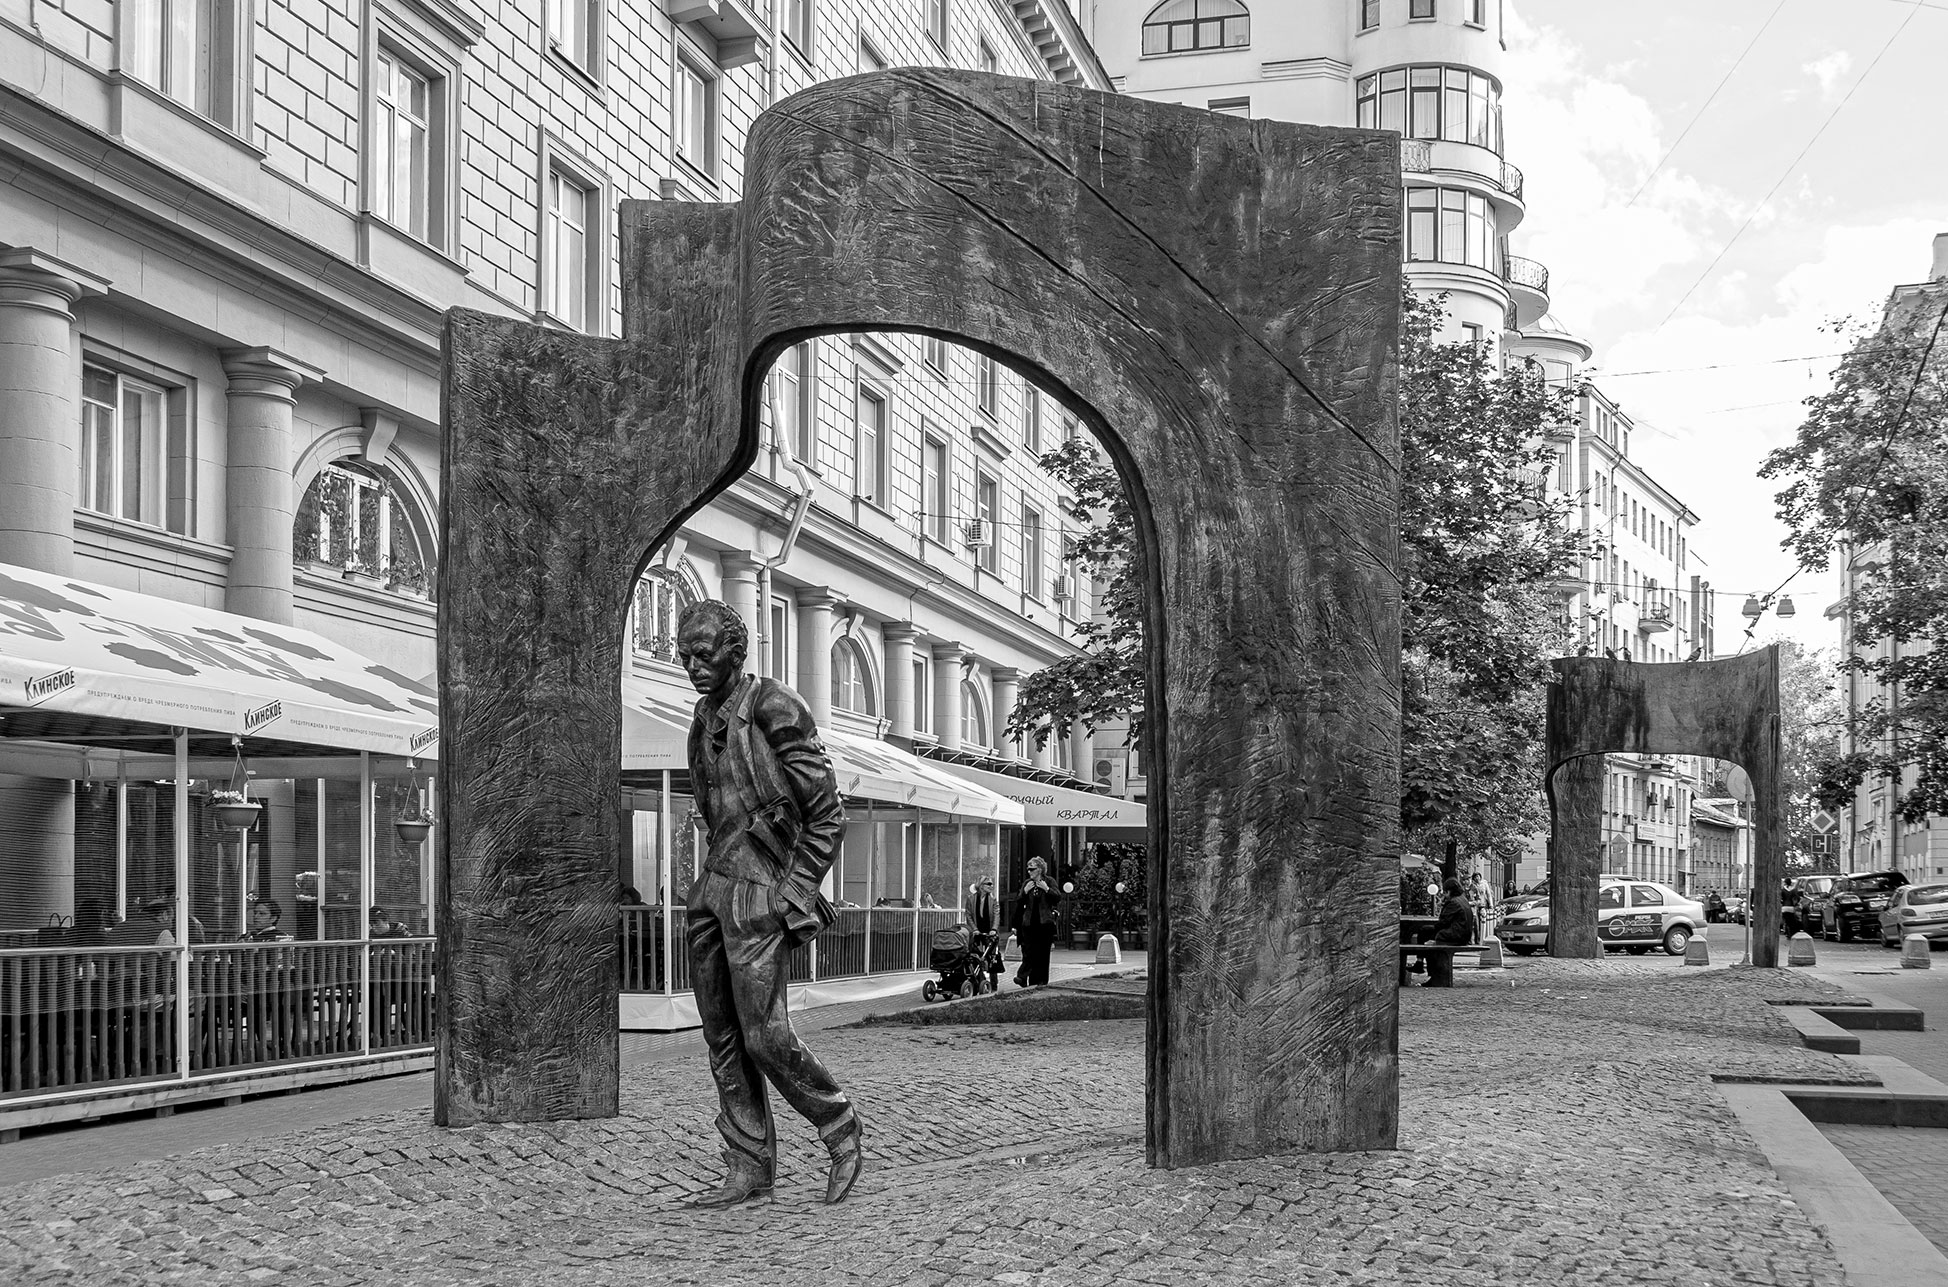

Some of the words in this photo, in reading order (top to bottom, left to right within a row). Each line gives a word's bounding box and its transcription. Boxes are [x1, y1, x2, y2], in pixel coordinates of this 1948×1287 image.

[24, 670, 75, 701] КЛИНСКОЕ
[244, 702, 281, 730] КЛИНСКОЕ
[1057, 809, 1118, 821] КВАРТАЛ
